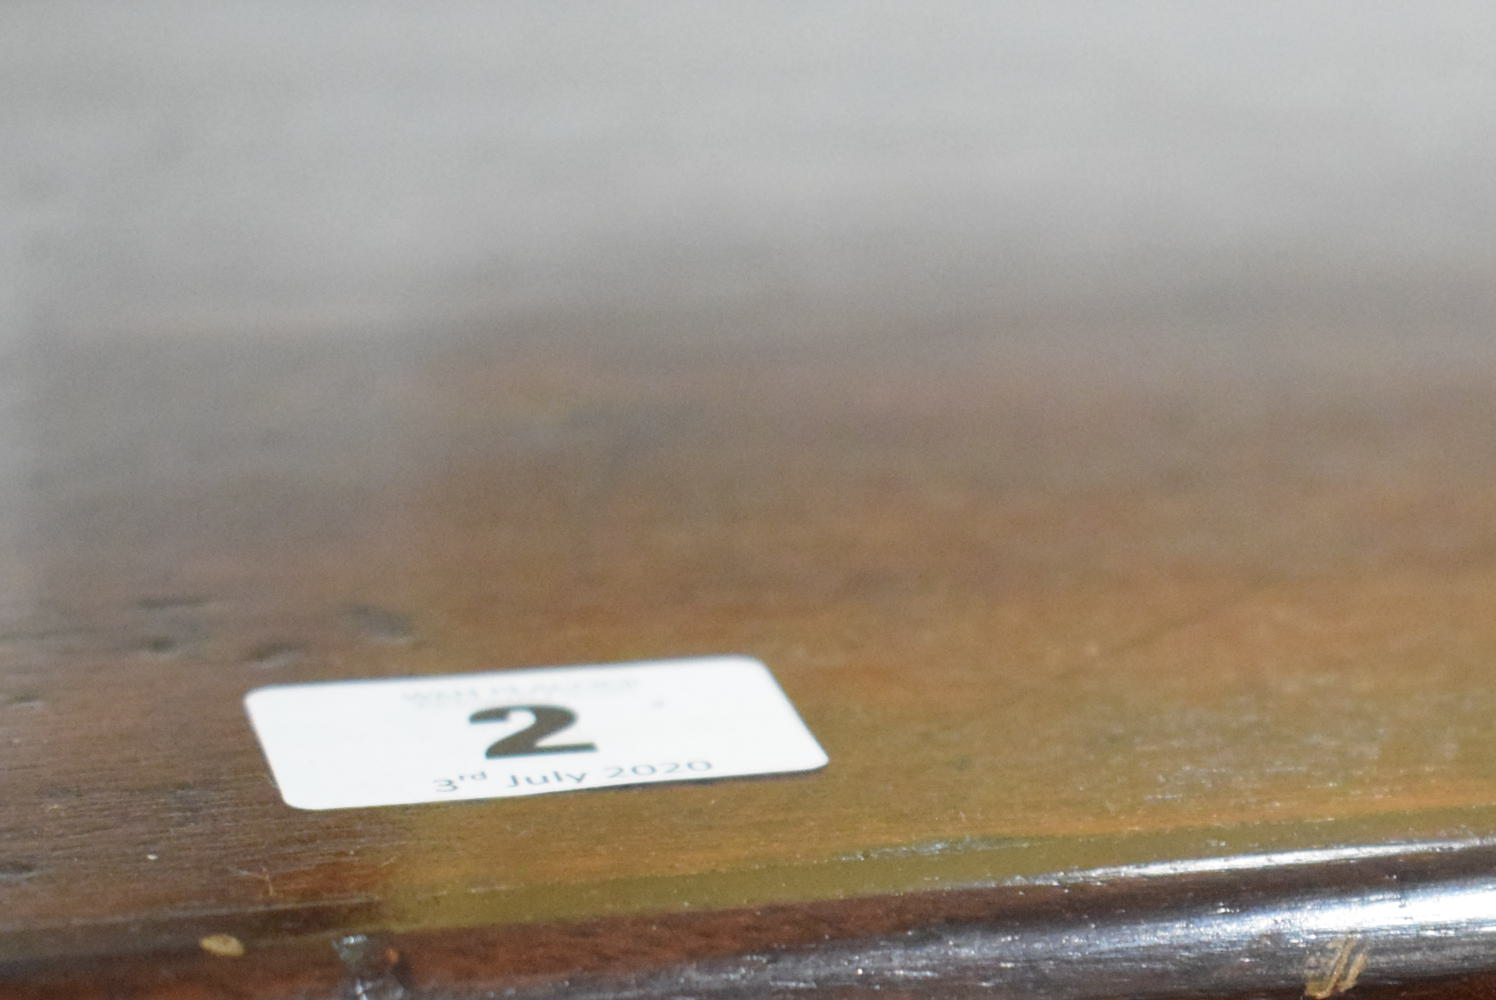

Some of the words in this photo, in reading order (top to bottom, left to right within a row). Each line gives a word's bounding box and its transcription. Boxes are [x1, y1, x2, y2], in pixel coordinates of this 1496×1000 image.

[469, 704, 597, 759] 2
[433, 770, 488, 793] 3rd
[506, 770, 588, 791] July
[605, 759, 714, 779] 2020
